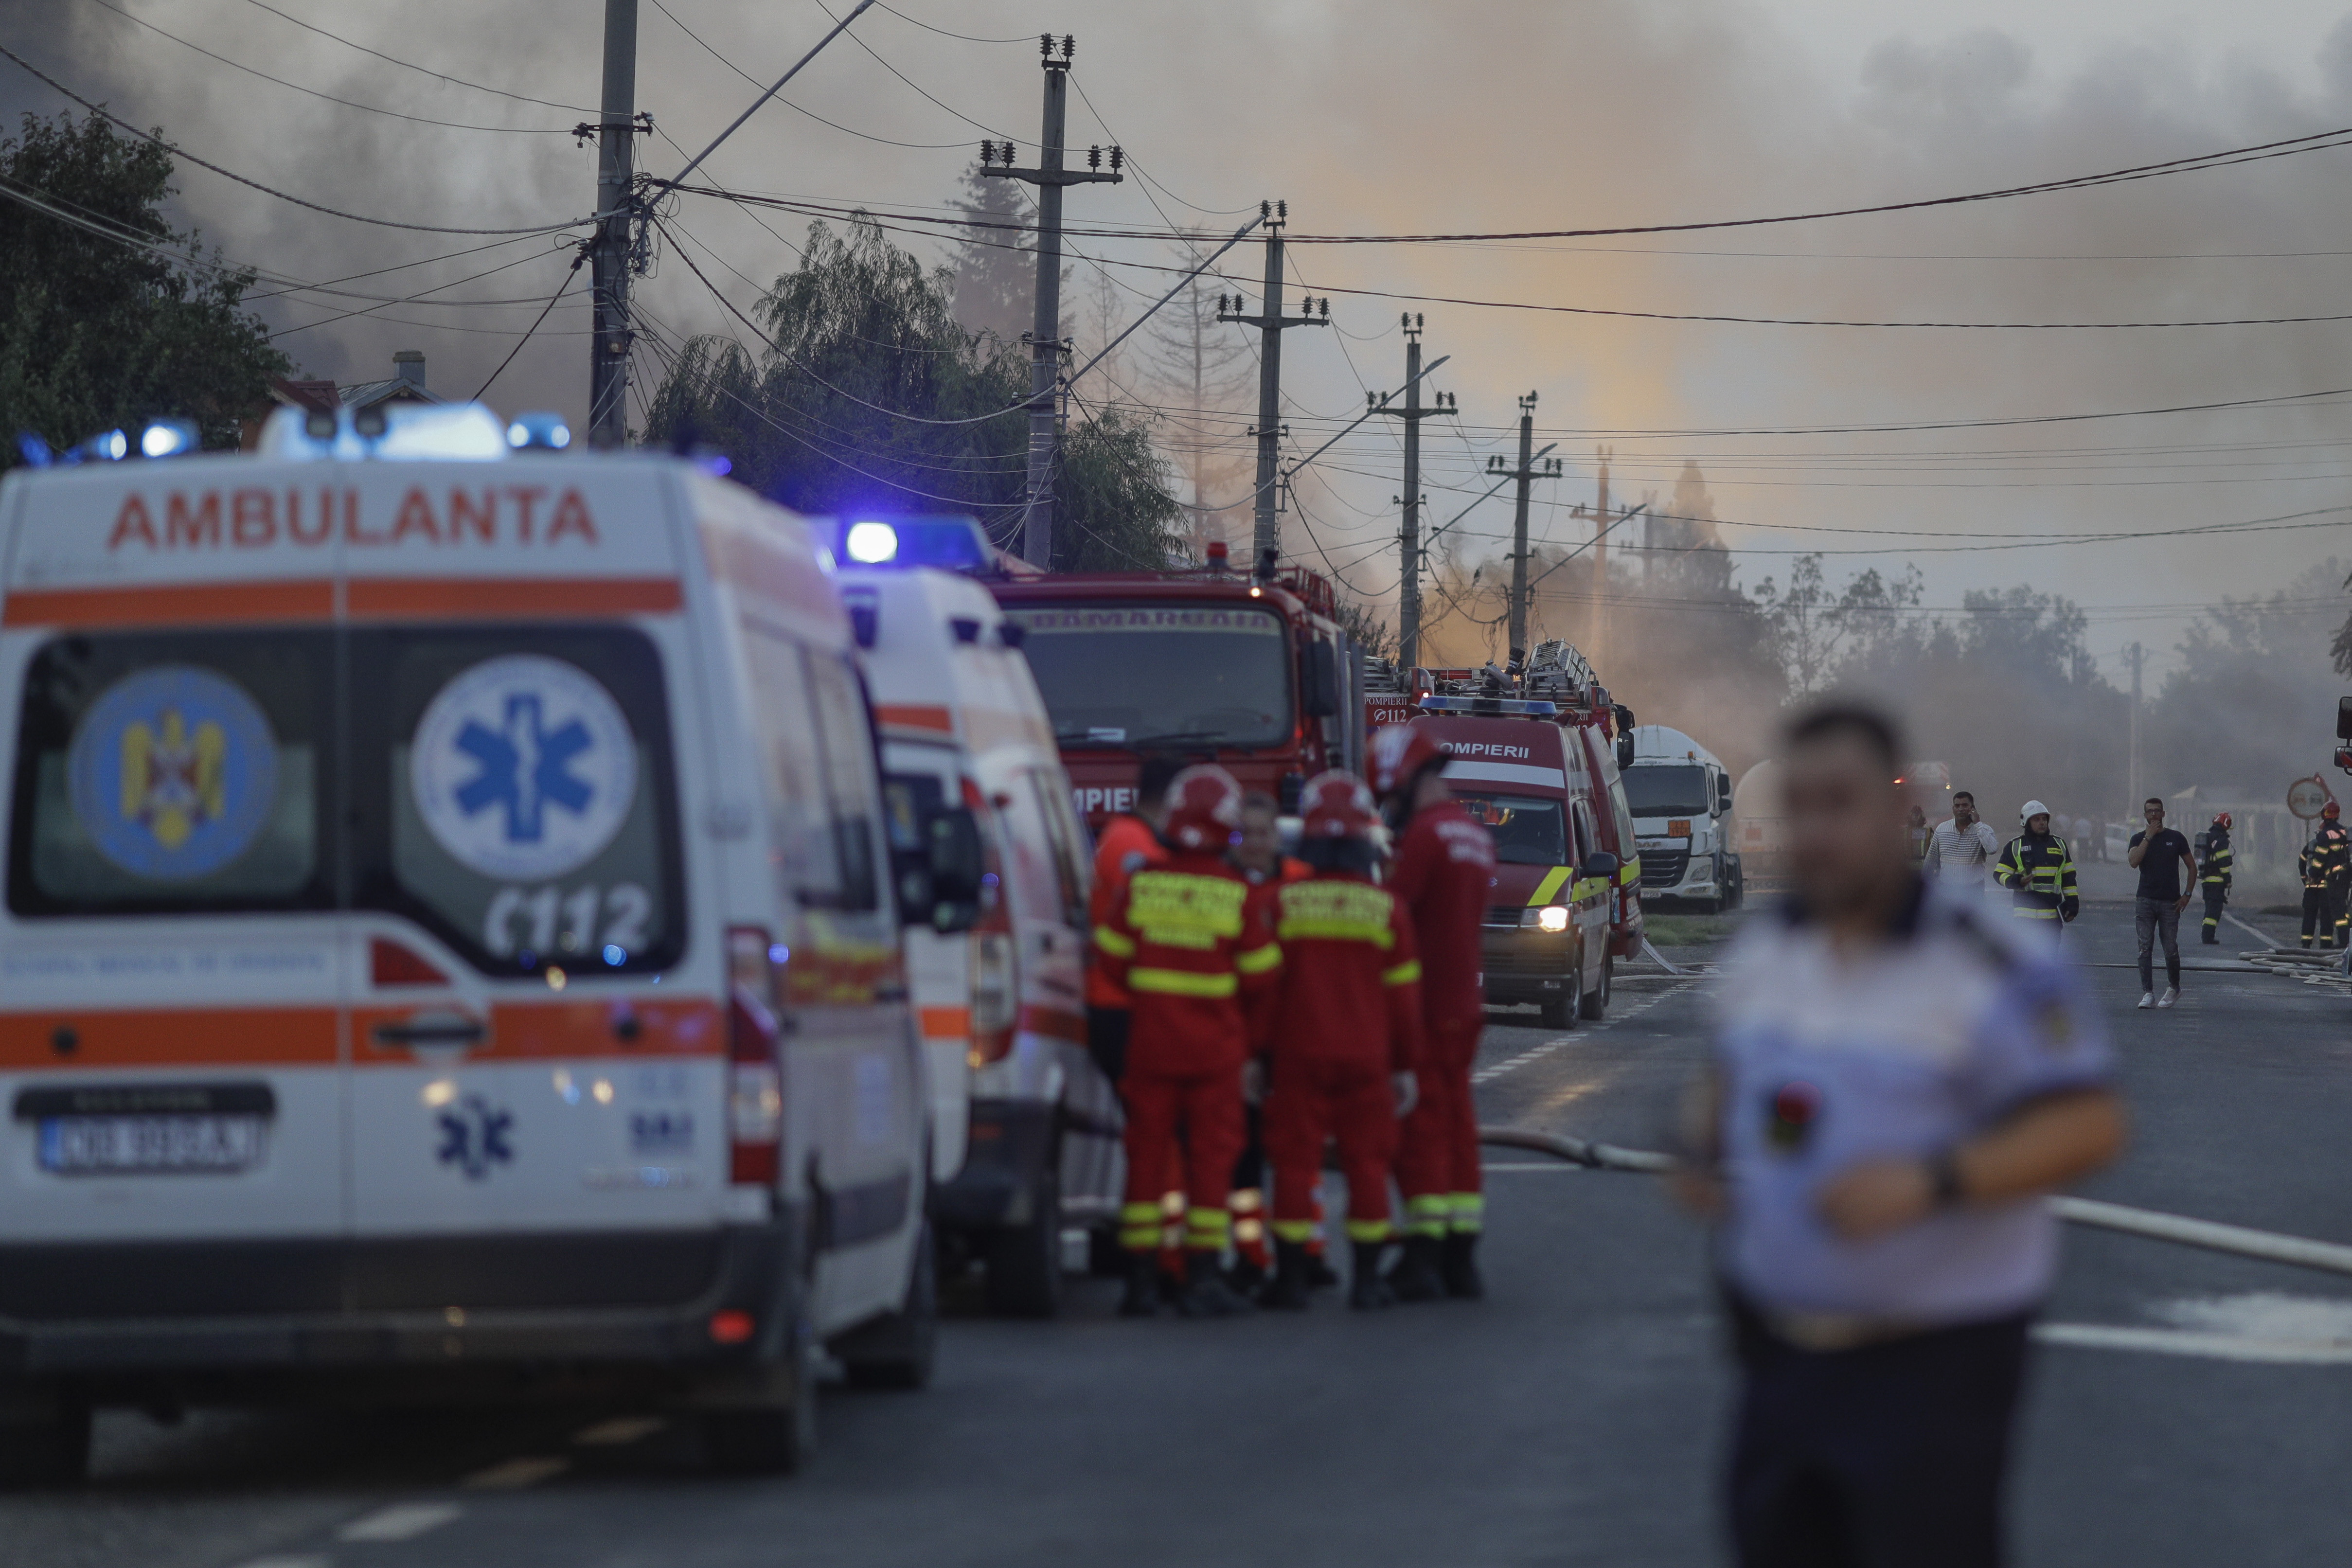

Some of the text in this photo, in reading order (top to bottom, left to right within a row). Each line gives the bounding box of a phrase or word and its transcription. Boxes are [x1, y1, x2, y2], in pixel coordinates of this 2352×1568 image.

[108, 484, 599, 550] AMBULANTA
[1387, 709, 1407, 722] 112
[1440, 742, 1529, 759] OMPIERII
